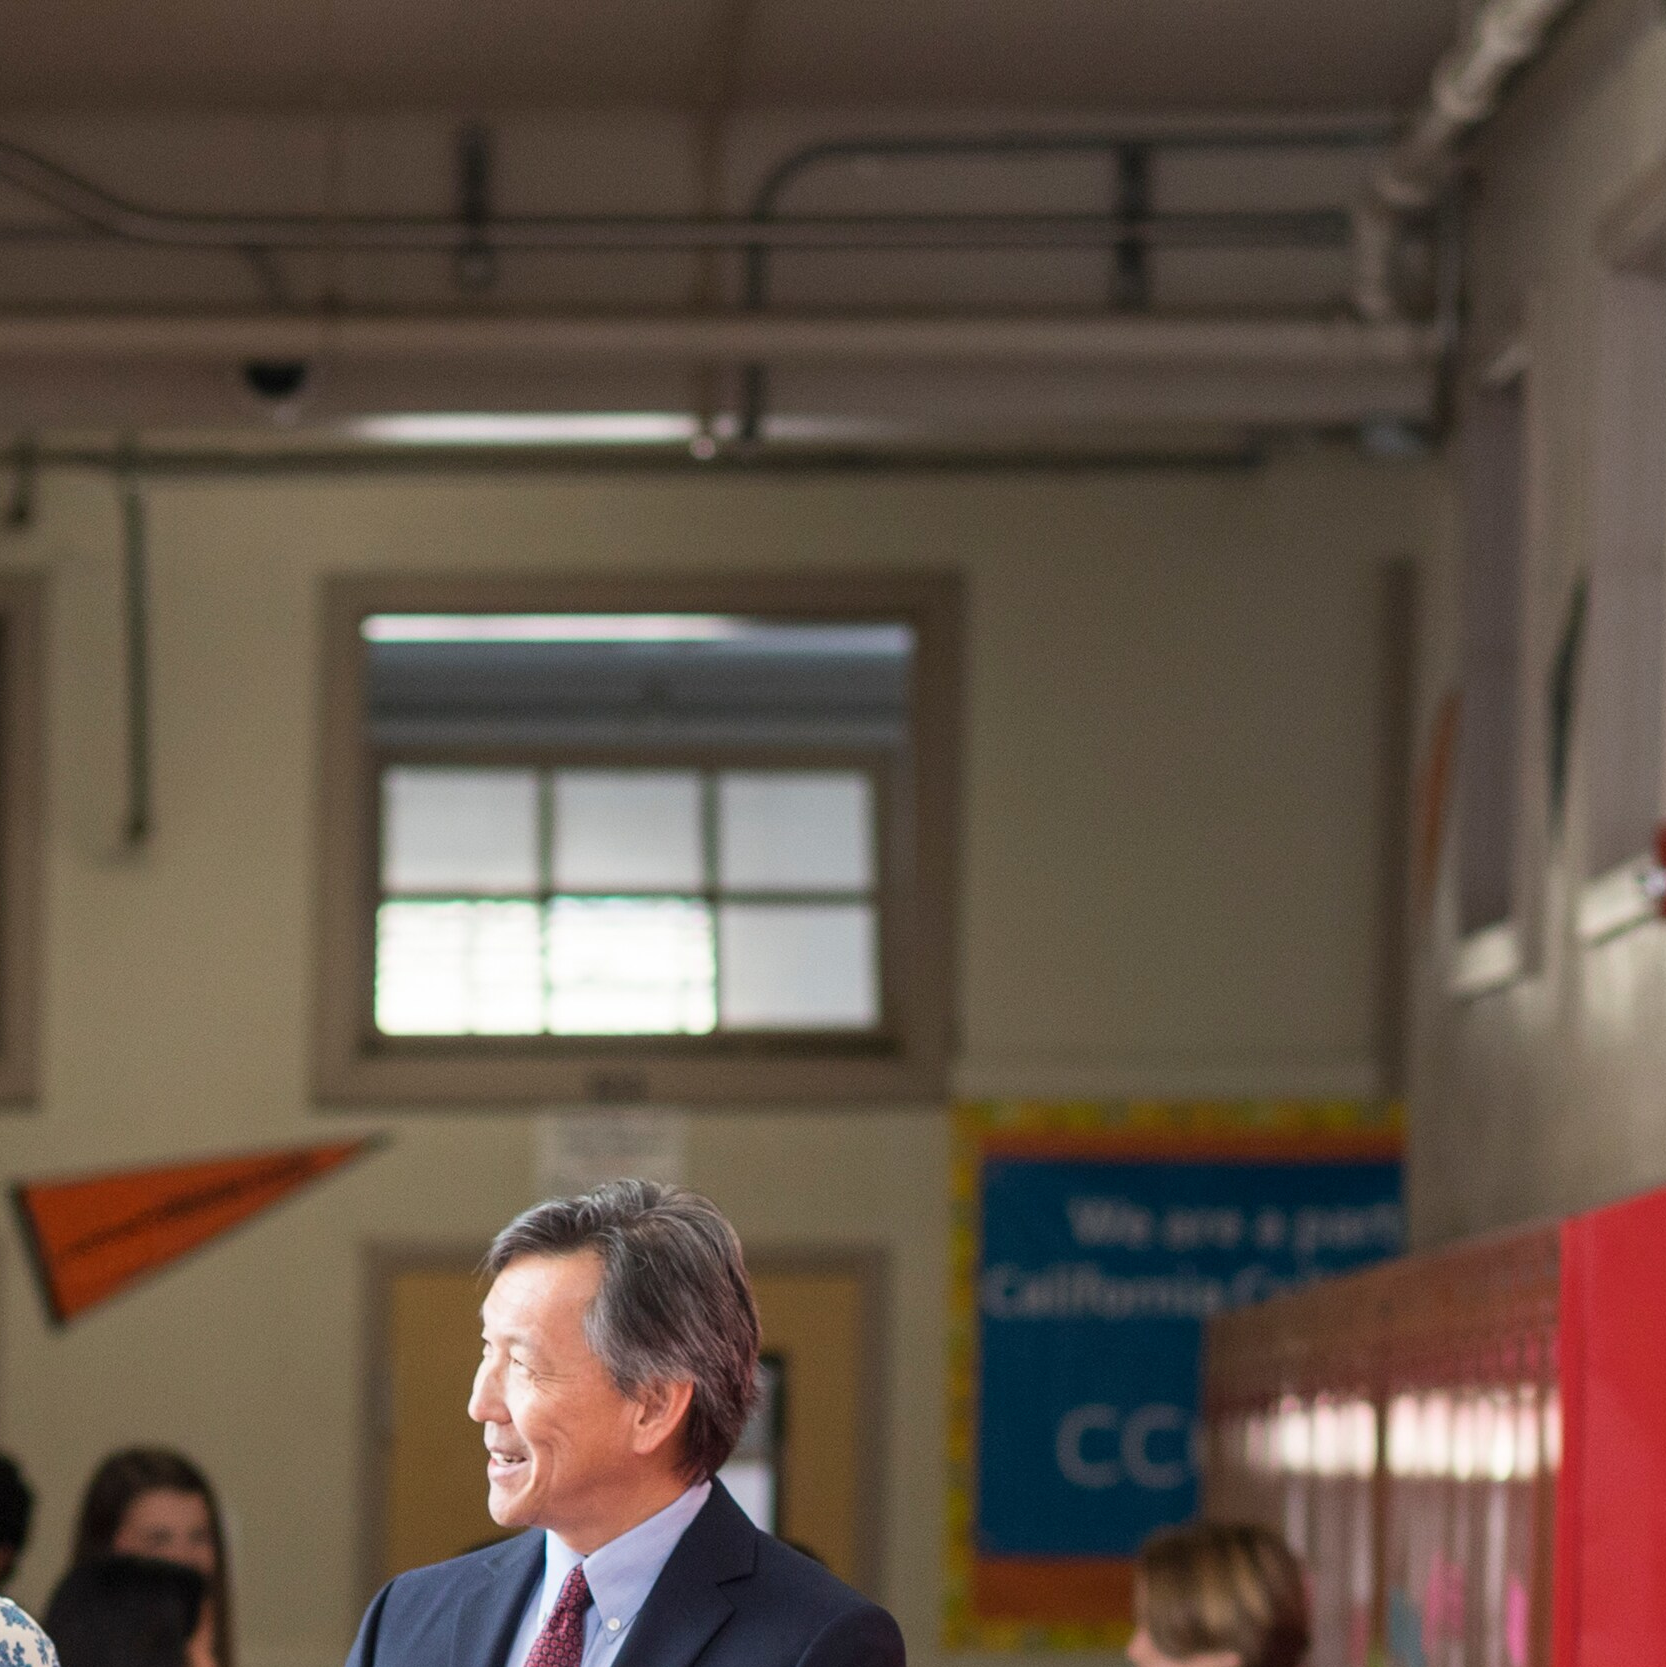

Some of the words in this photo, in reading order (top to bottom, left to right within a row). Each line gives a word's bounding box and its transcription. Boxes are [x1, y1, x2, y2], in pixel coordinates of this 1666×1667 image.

[1067, 1197, 1152, 1248] We
[1162, 1207, 1241, 1248] are
[1255, 1207, 1285, 1248] a
[982, 1263, 1222, 1318] California
[1056, 1403, 1203, 1489] CC
